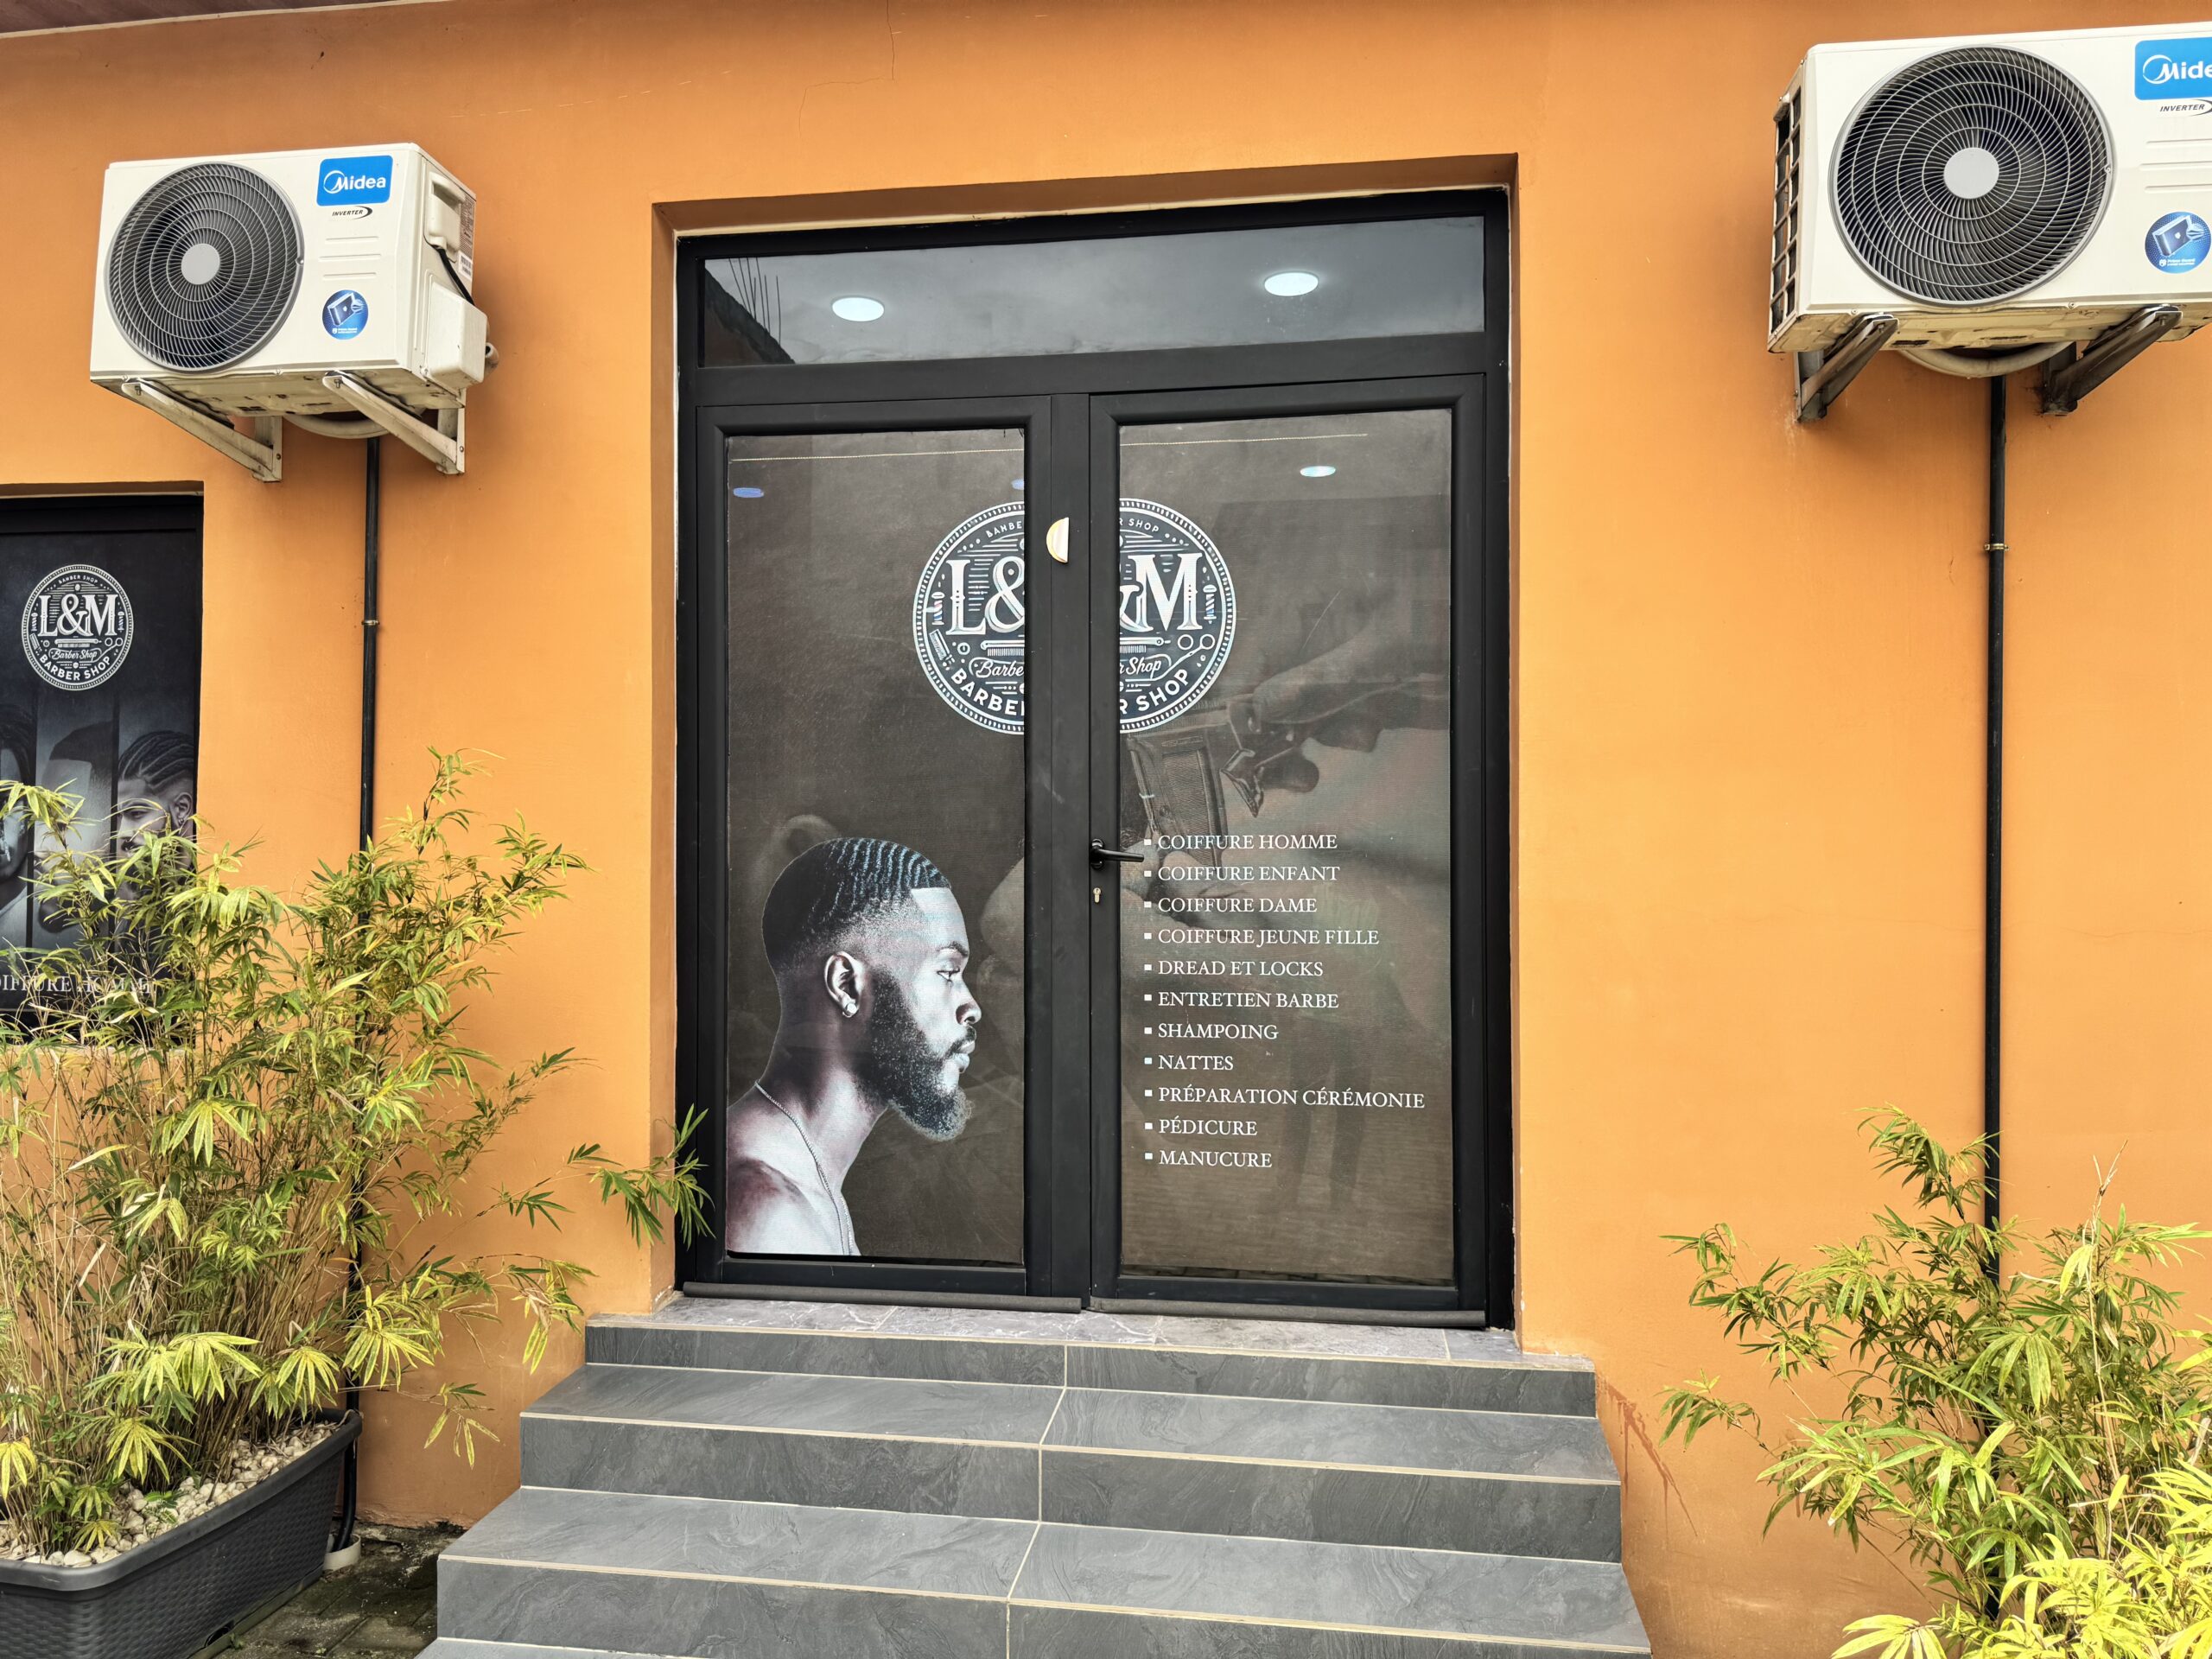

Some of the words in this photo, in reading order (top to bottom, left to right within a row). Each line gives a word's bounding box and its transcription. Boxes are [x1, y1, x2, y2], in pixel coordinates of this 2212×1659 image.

[2160, 104, 2205, 112] INVERTER
[323, 170, 387, 194] Midea
[1128, 518, 1160, 532] SHOP
[83, 575, 99, 584] SHOP
[38, 594, 119, 637] L&M
[52, 649, 79, 660] Barber
[79, 649, 98, 662] Shop
[40, 653, 81, 682] BARBER
[84, 655, 111, 679] SHOP
[1126, 656, 1162, 680] Shop
[1135, 668, 1189, 712] SHOP
[1158, 835, 1254, 849] COIFFURE
[1259, 835, 1338, 849] HOMME
[1158, 866, 1254, 881] COIFFURE
[1259, 866, 1340, 881] ENFANT
[1158, 898, 1254, 912] COIFFURE
[1259, 898, 1318, 912] DAME
[1158, 929, 1254, 944] COIFFURE
[1256, 929, 1320, 948] JEUNE
[1325, 930, 1380, 945] FILLE
[1158, 960, 1225, 976] DREAD
[1230, 961, 1255, 976] ET
[1259, 962, 1324, 976] LOCKS
[1158, 992, 1271, 1007] ENTRETIEN
[1275, 993, 1339, 1008] BARBE
[1158, 1023, 1279, 1039] SHAMPOING
[1158, 1054, 1234, 1071] NATTES
[1159, 1084, 1297, 1105] PRÉPARATION
[1302, 1087, 1426, 1109] CÉRÉMONIE
[1160, 1116, 1258, 1136] PÉDICURE
[1159, 1149, 1273, 1168] MANUCURE
